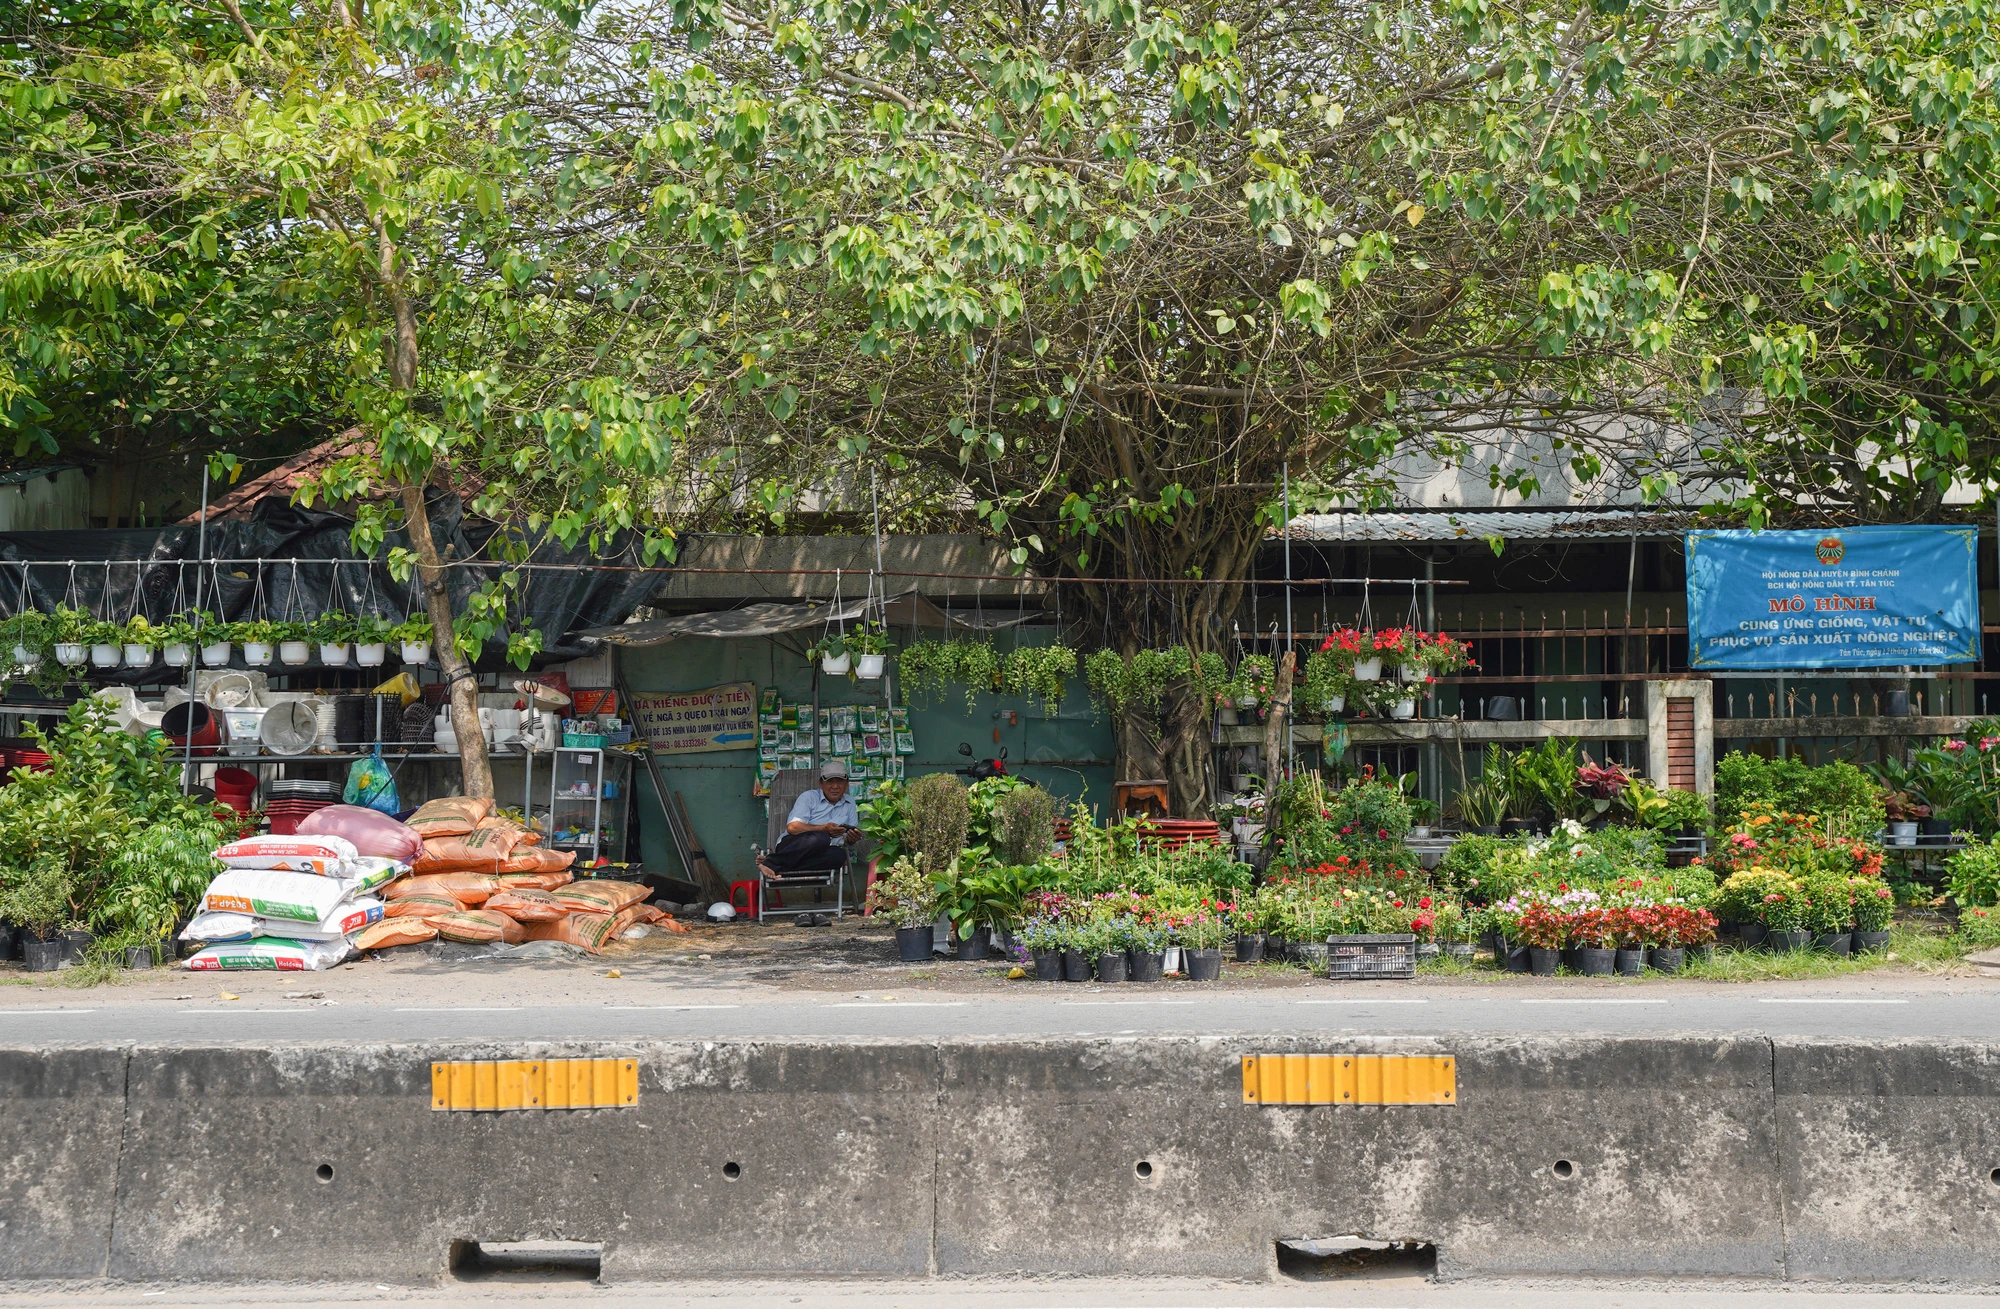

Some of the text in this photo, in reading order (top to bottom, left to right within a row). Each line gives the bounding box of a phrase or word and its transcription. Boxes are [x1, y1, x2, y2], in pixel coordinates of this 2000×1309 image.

[1762, 569, 1900, 580] HỘI NÔNG DÂN HUYỆN BÌNH CHÁNH
[1767, 578, 1895, 590] BCH HỘI NÔNG DÂN TT. TÂN TÚC
[1768, 593, 1877, 613] MÔ HÌNH
[1739, 614, 1927, 631] CUNG ỨNG GIỐNG, VẬT TƯ
[1709, 629, 1958, 648] PHỤC VỤ SẢN XUẤT NÔNG NGHIỆP
[1839, 648, 1851, 657] Tân
[1866, 648, 1881, 658] ngày
[1910, 647, 1918, 655] 10
[634, 698, 650, 711] ỰA
[656, 710, 674, 722] NGÃ
[676, 711, 682, 721] 3
[684, 710, 707, 722] QUẸO
[662, 727, 672, 736] 135
[673, 725, 686, 735] NHÌN
[686, 724, 697, 734] VÀO
[221, 847, 238, 855] 612
[219, 900, 247, 909] 9034P
